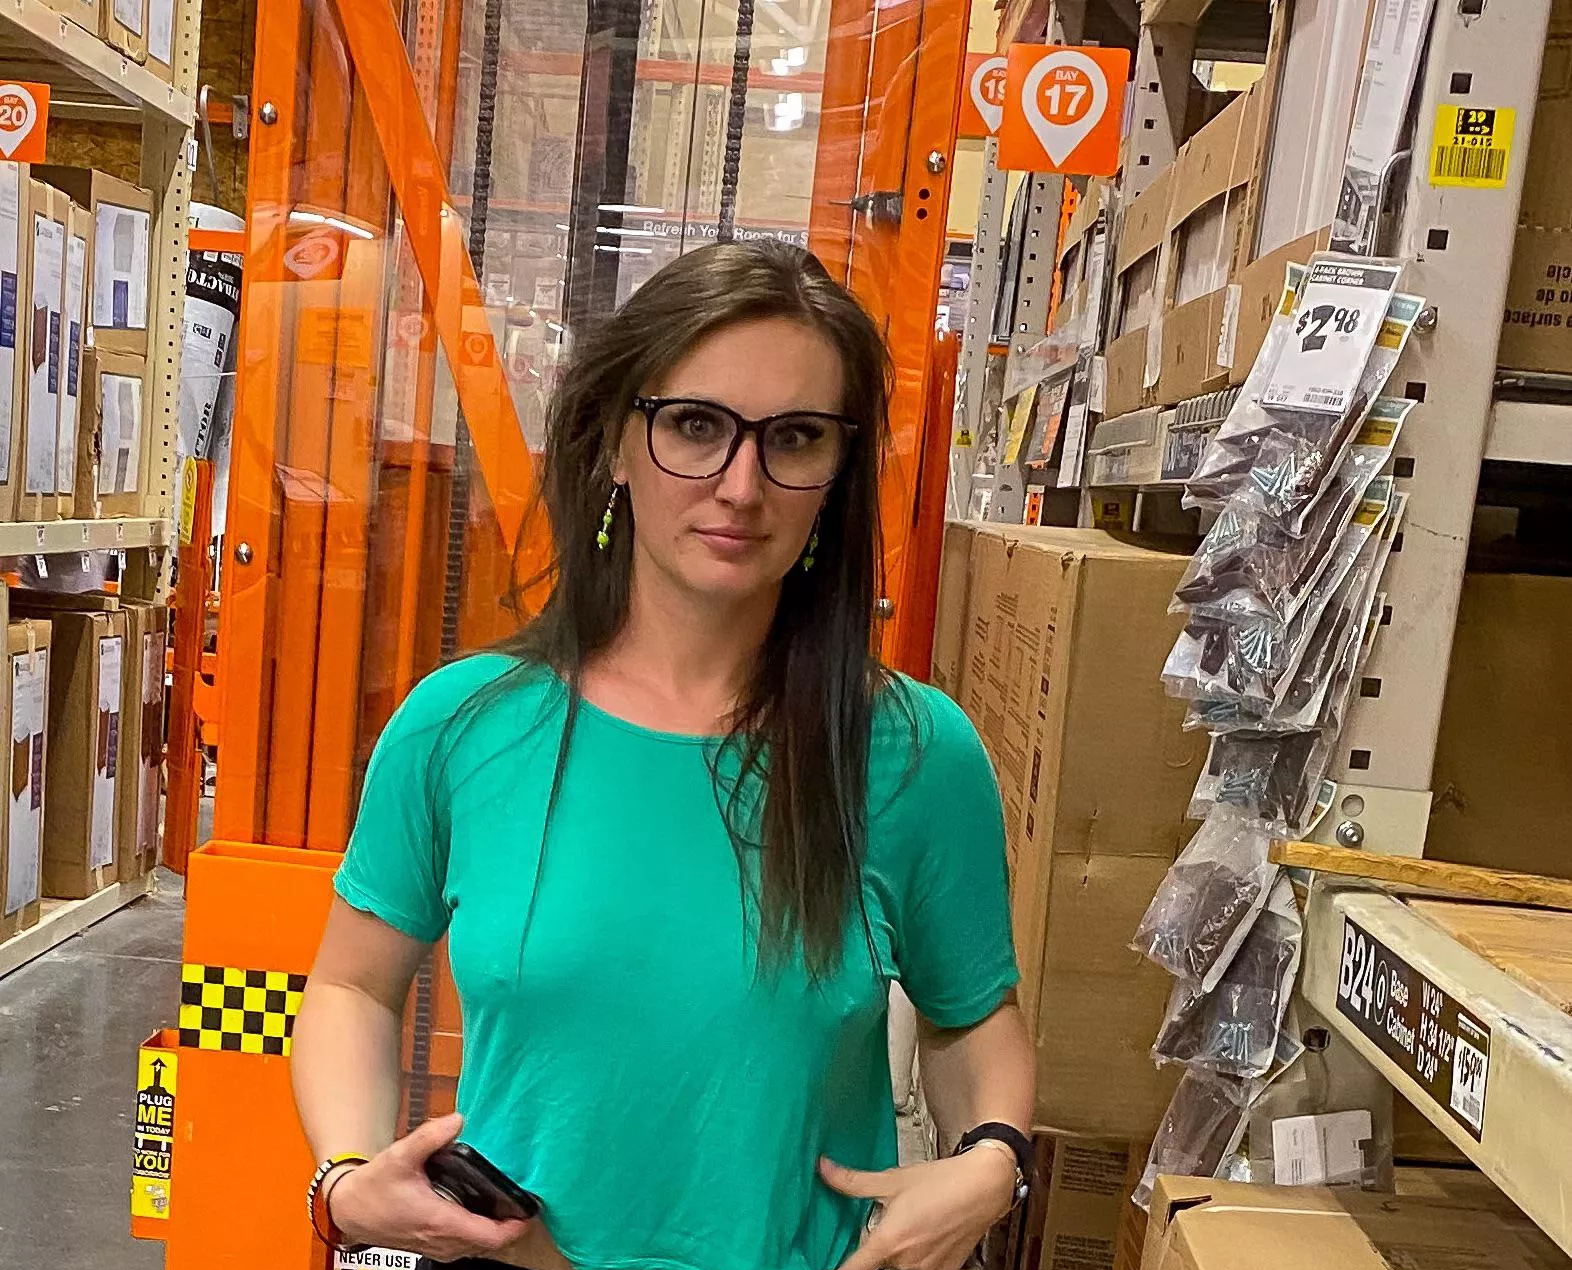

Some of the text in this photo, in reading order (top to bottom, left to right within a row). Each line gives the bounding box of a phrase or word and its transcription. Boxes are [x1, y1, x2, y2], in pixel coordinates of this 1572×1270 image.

[1055, 70, 1080, 81] BAY
[1044, 83, 1088, 116] 17
[0, 104, 27, 127] 20
[1339, 923, 1376, 1020] B24
[1390, 969, 1409, 1008] Base
[1422, 980, 1431, 1009] W
[1386, 1006, 1416, 1055] Cabinet
[1419, 1012, 1428, 1042] H
[1427, 1019, 1438, 1050] 34
[1416, 1051, 1424, 1073] D
[139, 1092, 173, 1107] PLUG
[137, 1104, 173, 1126] ME
[145, 1125, 171, 1135] TODAY
[133, 1153, 170, 1172] YOU
[339, 1251, 381, 1267] NEVER
[385, 1254, 411, 1269] USE
